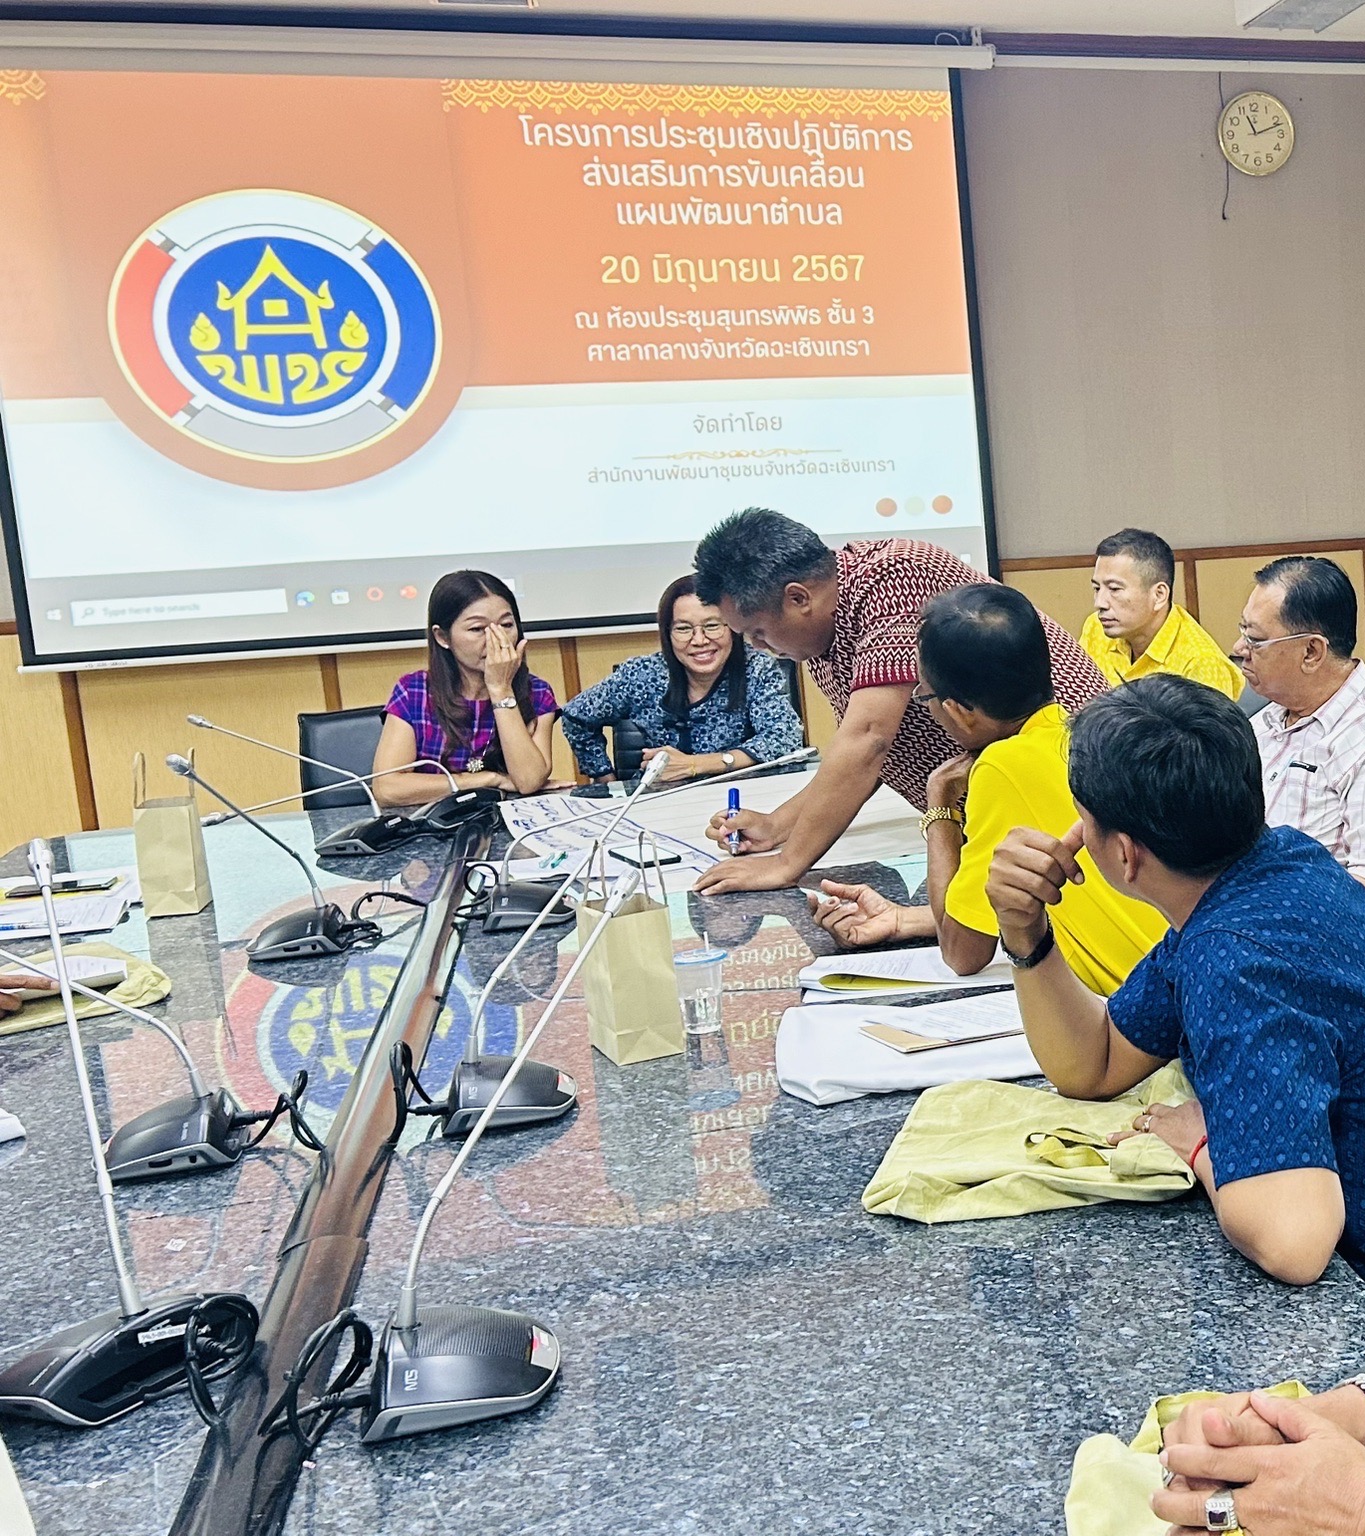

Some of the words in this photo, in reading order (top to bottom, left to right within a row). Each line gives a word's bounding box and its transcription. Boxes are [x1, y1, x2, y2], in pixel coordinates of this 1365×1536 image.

[1238, 106, 1246, 115] 11
[1249, 102, 1259, 113] 12
[1264, 105, 1268, 114] 1
[1229, 116, 1240, 127] 10
[1272, 115, 1281, 125] 2
[518, 114, 914, 156] โครงการประชุมเชิงปฏิบัติการ
[1226, 129, 1235, 140] 9
[1276, 129, 1285, 139] 3
[1231, 143, 1240, 153] 8
[1273, 142, 1282, 151] 4
[1242, 153, 1249, 163] 7
[1253, 156, 1262, 166] 6
[1265, 153, 1274, 163] 5
[582, 156, 866, 188] ส่งเสริมการขับเคลื่อน
[616, 196, 844, 226] แผนพัฒนาตำบล
[600, 255, 641, 284] 20
[652, 253, 781, 293] มิถุนายน
[791, 254, 866, 283] 2567
[574, 310, 600, 330] ณ
[606, 303, 822, 333] ห้องประชุมสุนทรพิพิธ
[826, 298, 856, 326] ชั้น
[861, 305, 876, 326] 3
[587, 337, 871, 362] ศาลากลางจังหวัดฉะเชิงเทรา
[692, 411, 784, 434] จัดทำโดย
[587, 457, 897, 484] สำนักงานพัฒนาชุมชนจังหวัดฉะเชิงเทรา
[404, 1368, 419, 1392] NTS
